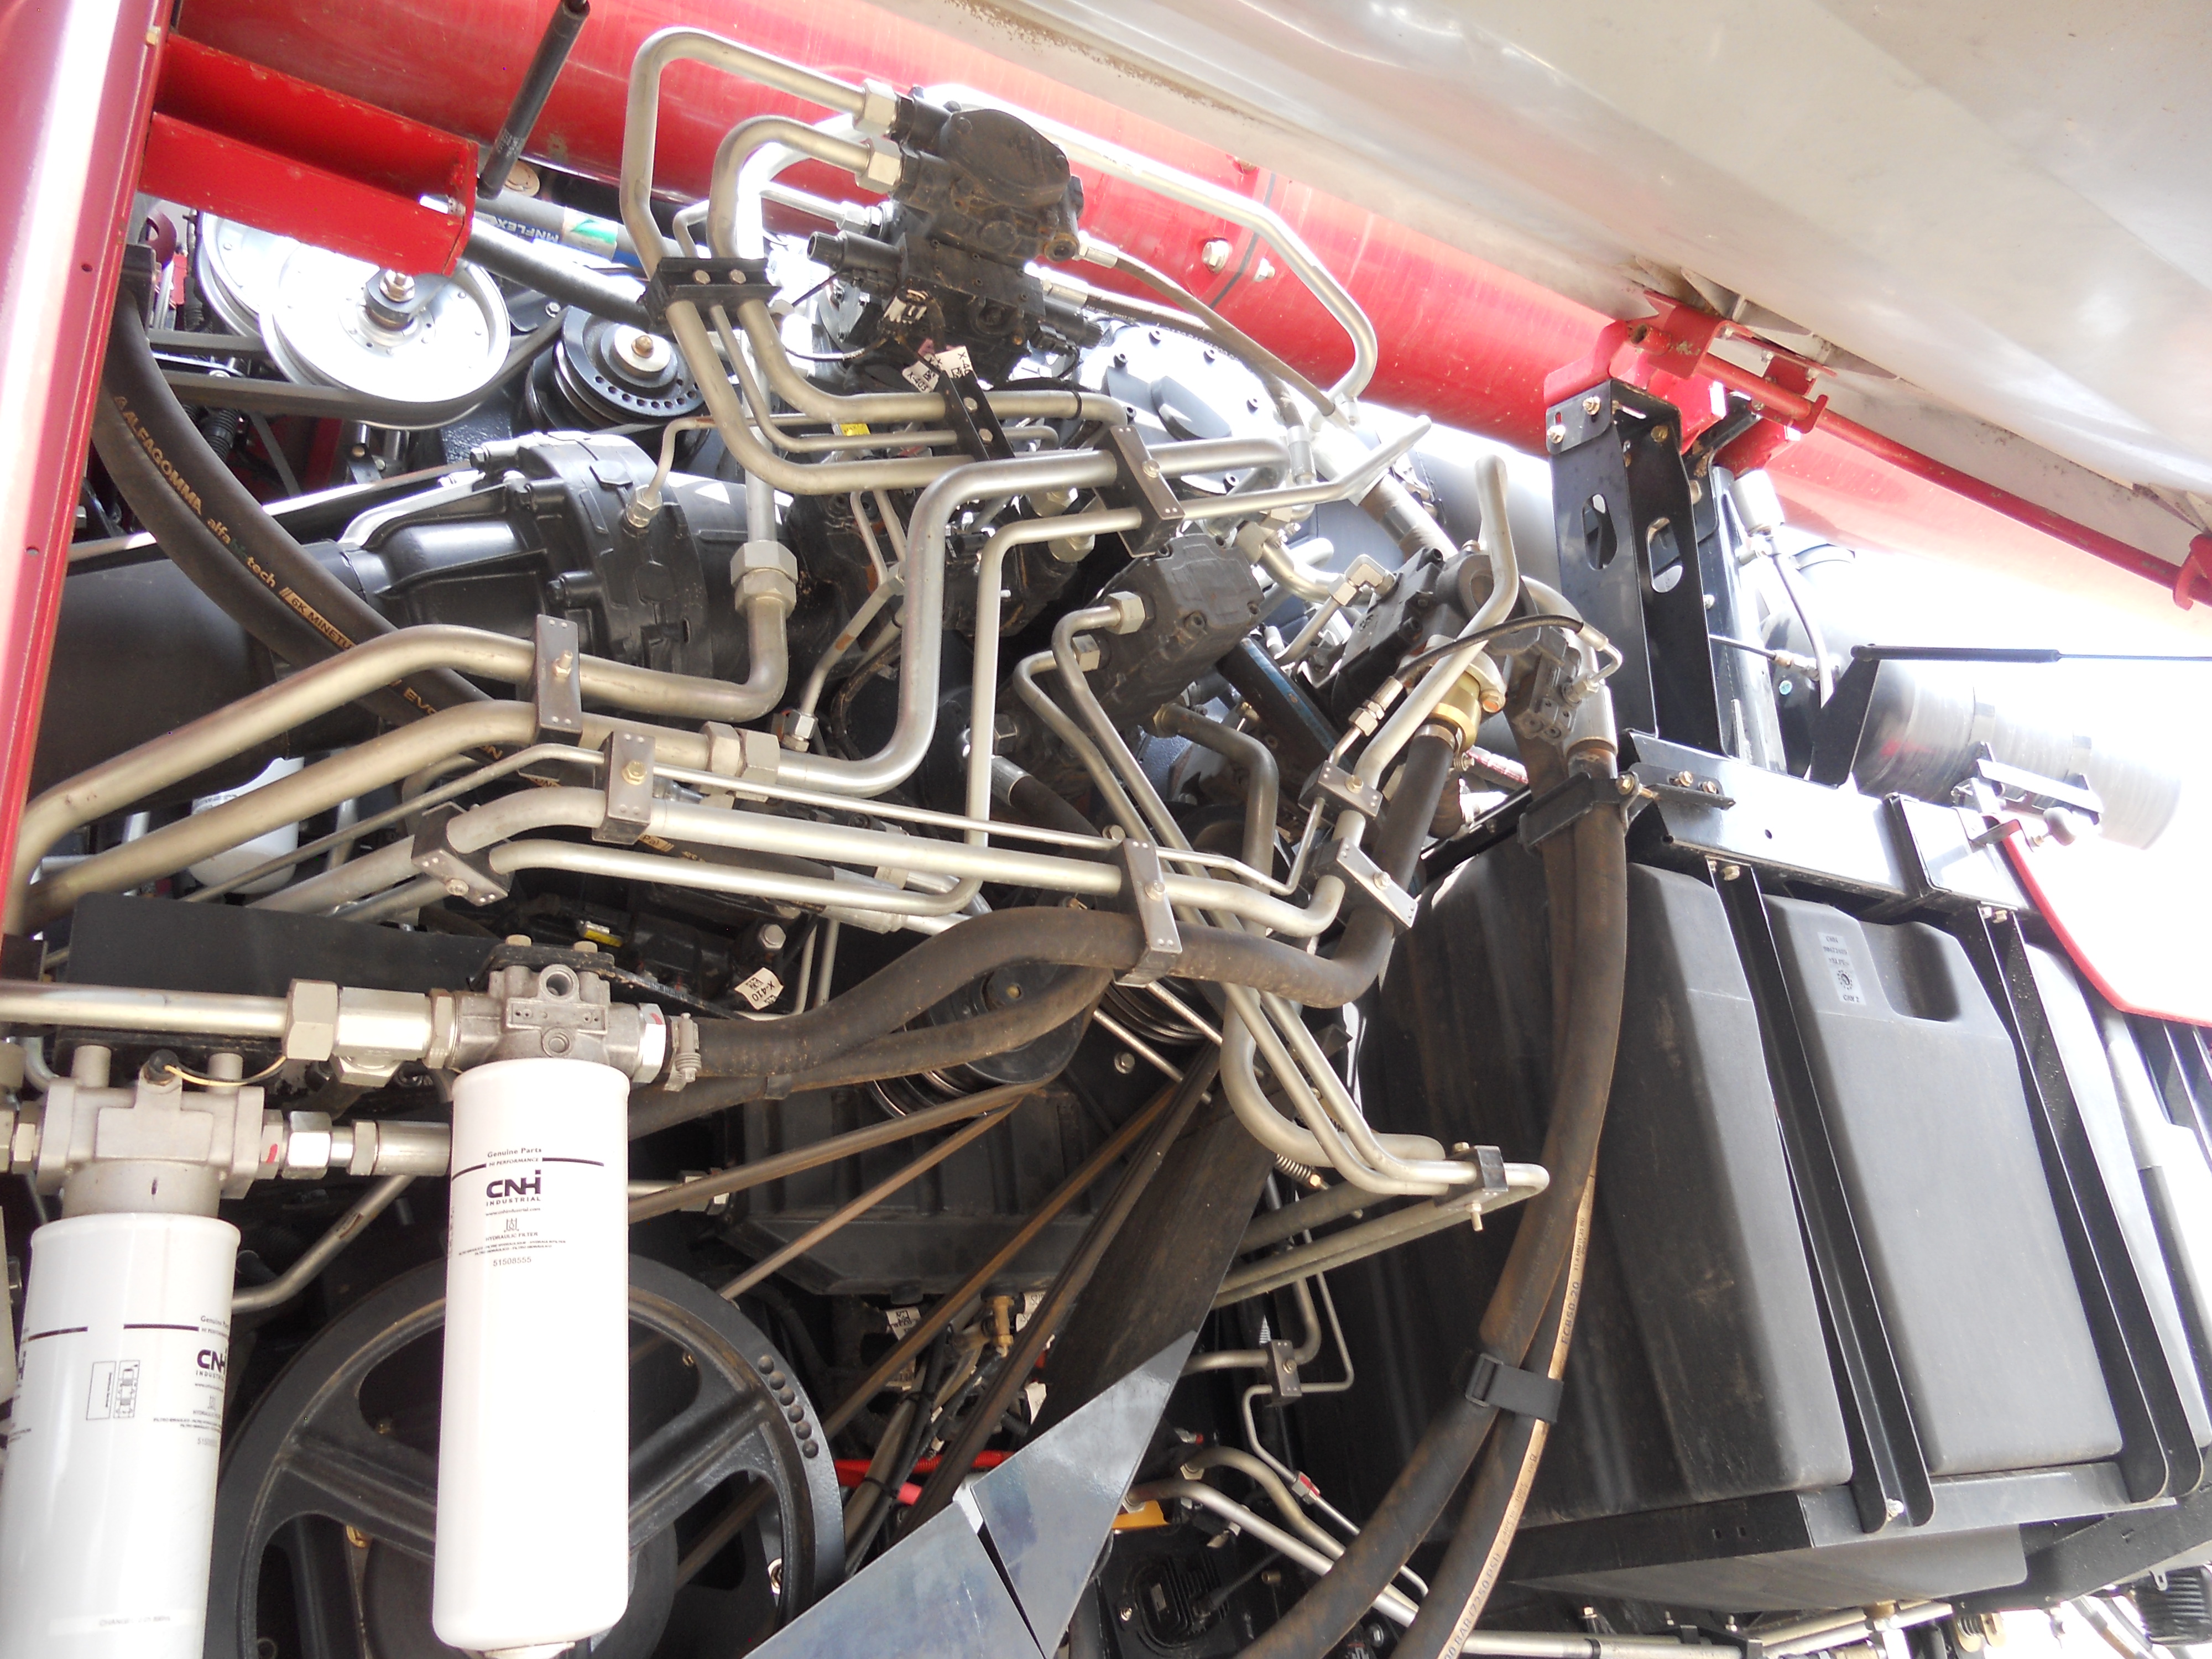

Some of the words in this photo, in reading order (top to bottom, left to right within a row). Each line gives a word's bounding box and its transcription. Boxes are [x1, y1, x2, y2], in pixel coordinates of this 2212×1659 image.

[123, 411, 202, 515] ALFAGOMMA
[291, 597, 307, 613] 6K
[752, 980, 775, 1001] X-410
[487, 1149, 518, 1158] Genuine
[496, 1157, 539, 1166] PERFORMANCE
[486, 1196, 541, 1207] INDUSTRIAL
[485, 1233, 517, 1242] HYDRAULIC
[1454, 1618, 1472, 1647] BAR
[1469, 1579, 1490, 1618] (7250
[1486, 1552, 1501, 1578] PSI)
